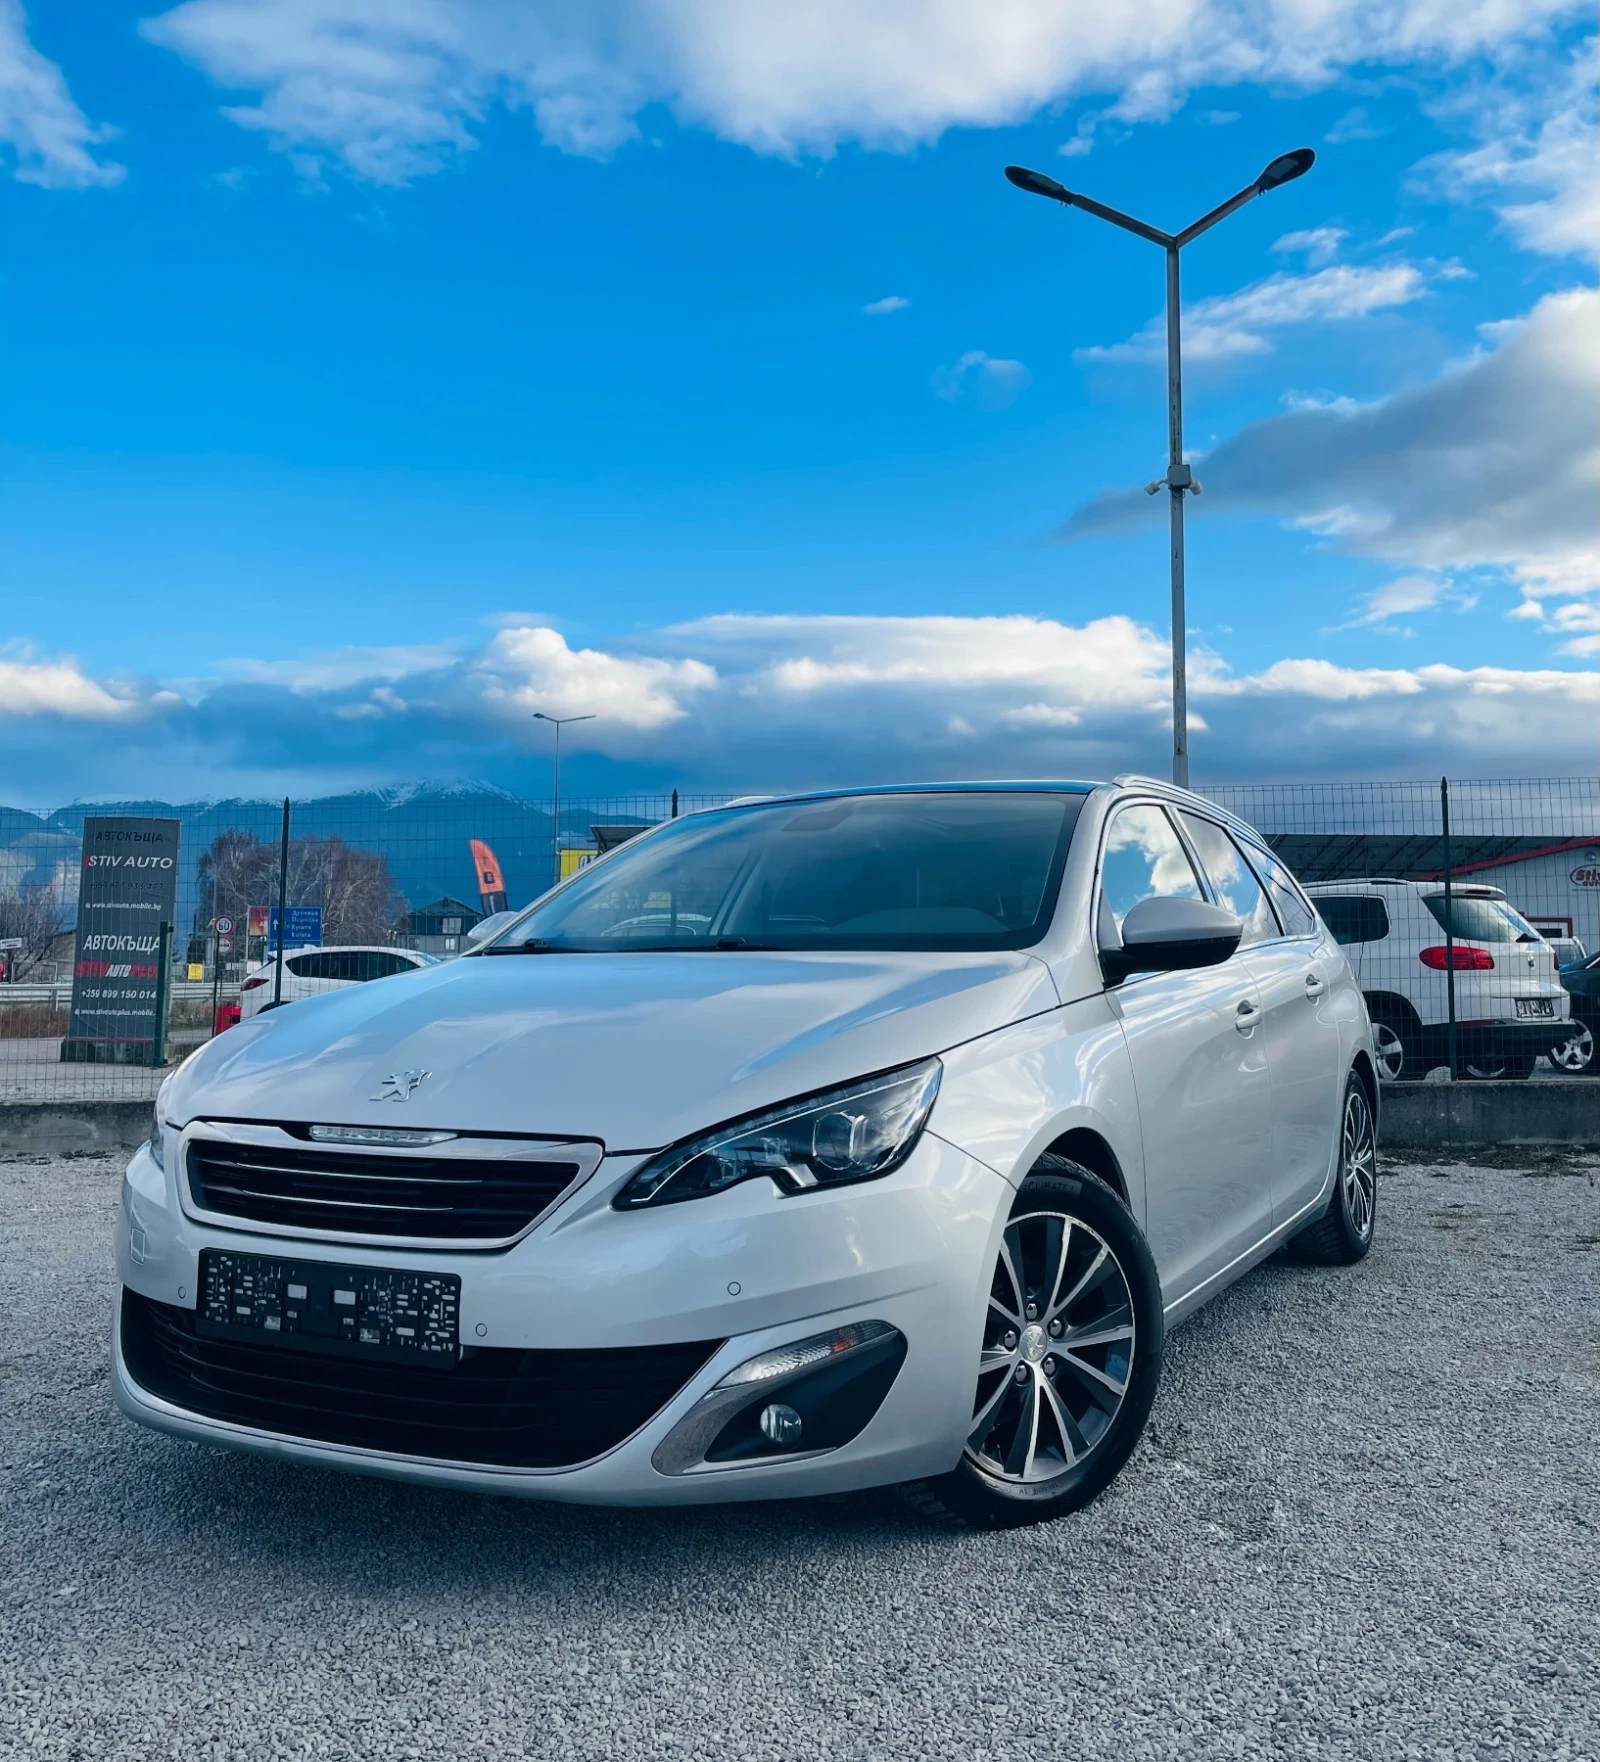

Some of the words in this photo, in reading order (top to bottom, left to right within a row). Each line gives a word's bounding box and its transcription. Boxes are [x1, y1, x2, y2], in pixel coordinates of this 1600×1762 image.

[95, 831, 163, 843] АВТОКЪЩА
[85, 855, 122, 868] STIV
[123, 856, 173, 869] AUTO
[218, 920, 230, 931] 60
[83, 935, 160, 955] АВТОКЪЩА
[81, 989, 100, 998] +359
[102, 989, 118, 998] 899
[120, 990, 137, 998] 150
[139, 990, 156, 999] 014
